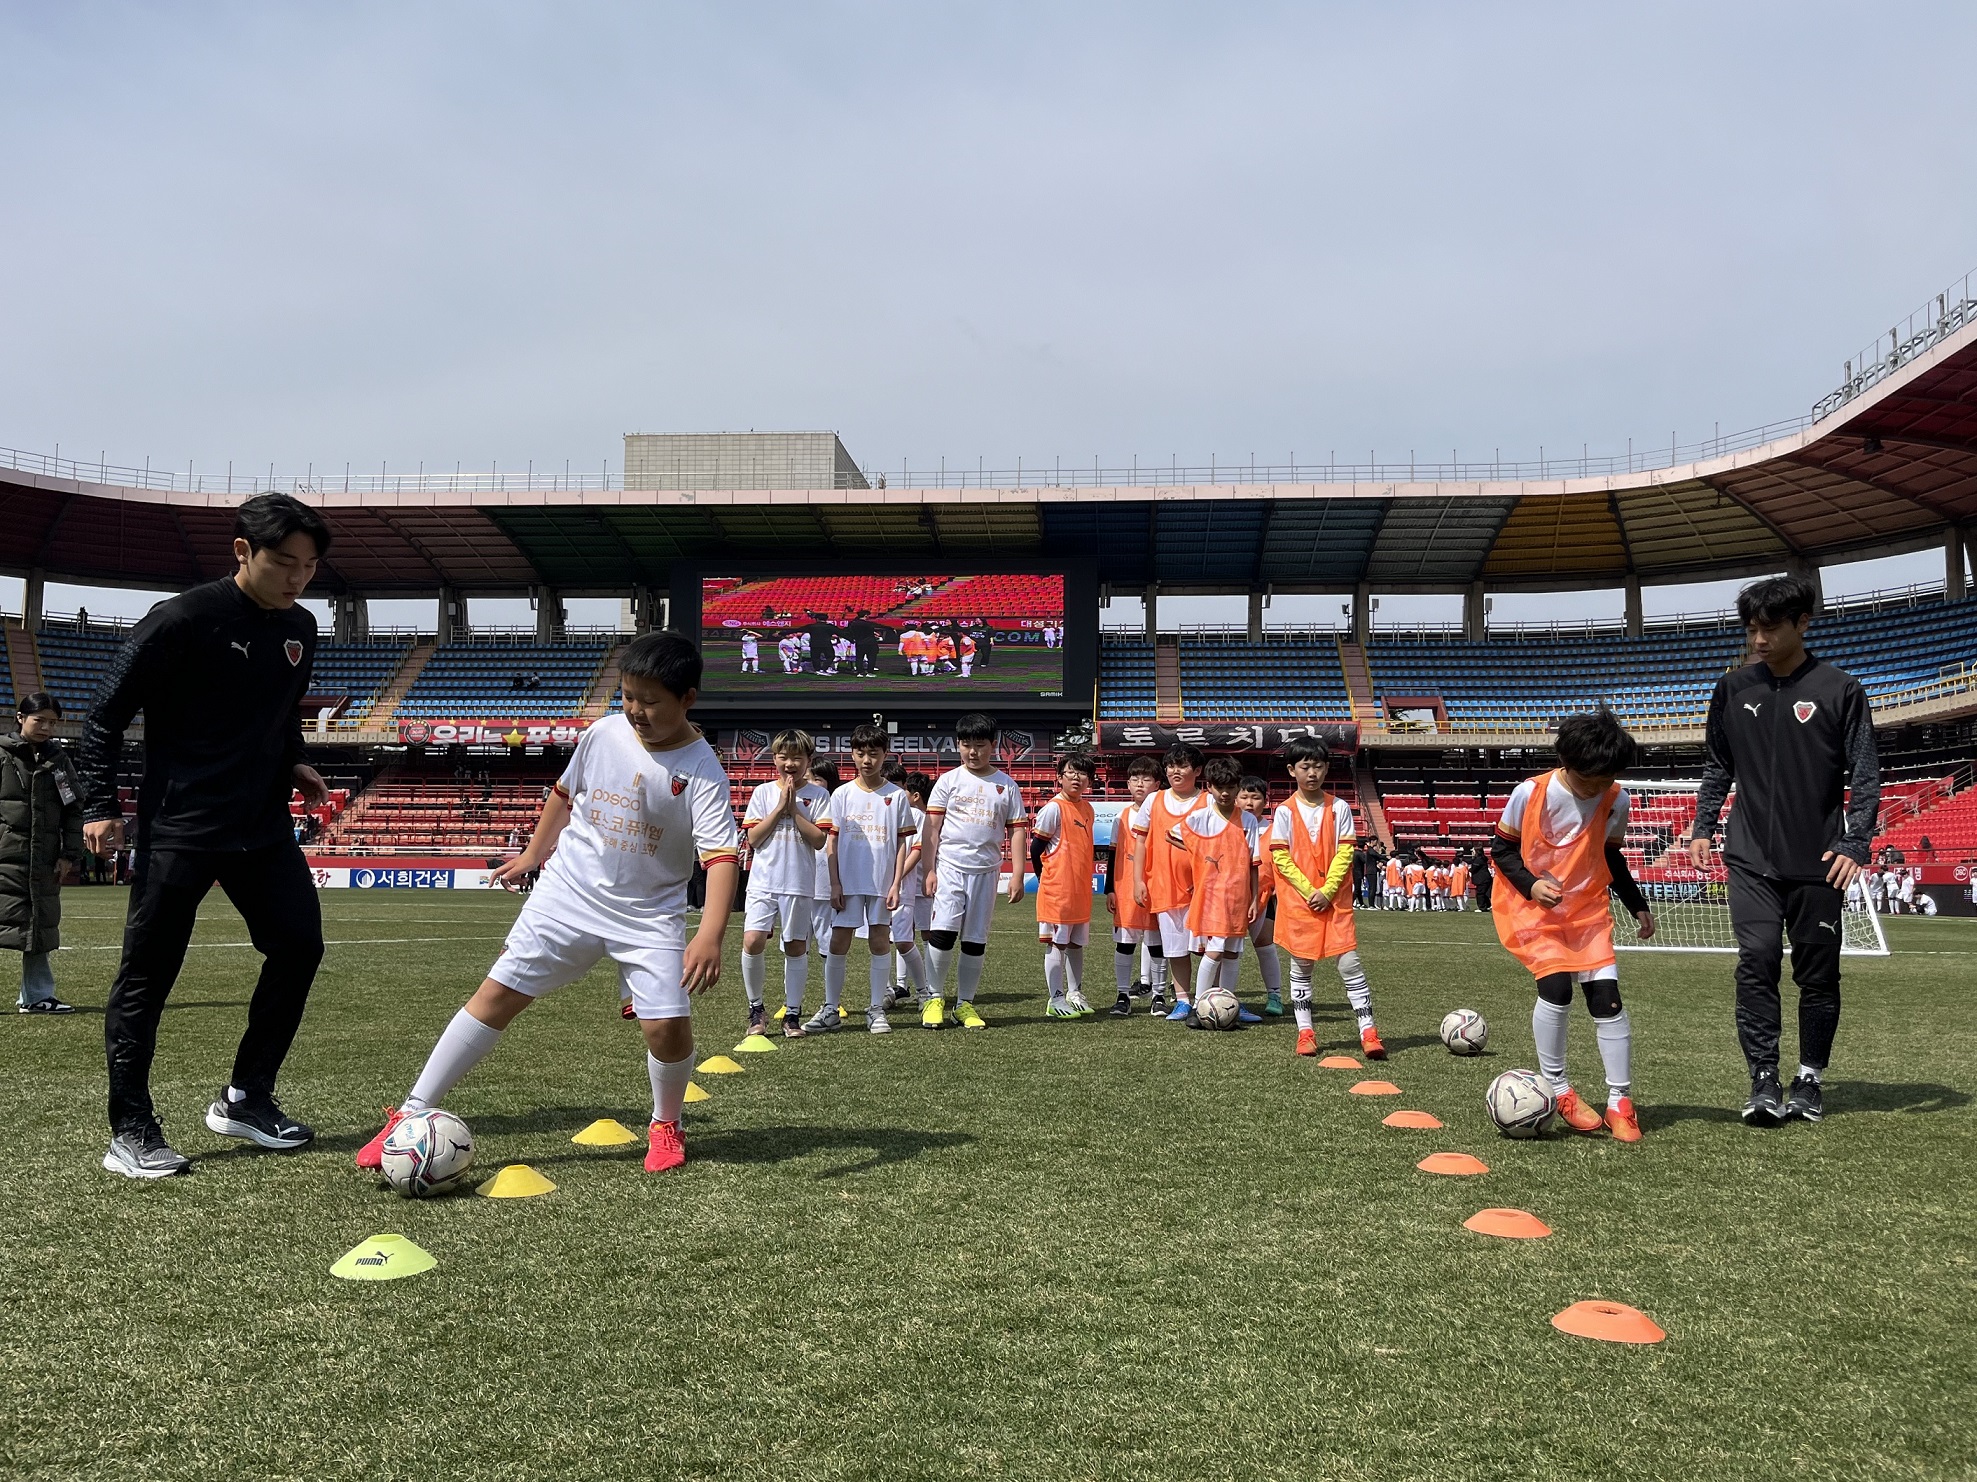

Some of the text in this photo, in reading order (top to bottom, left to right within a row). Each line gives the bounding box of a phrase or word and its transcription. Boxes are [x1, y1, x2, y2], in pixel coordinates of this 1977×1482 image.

[994, 631, 1040, 642] COM
[526, 725, 588, 748] 포항
[888, 736, 960, 753] EELYA
[592, 788, 641, 812] posco
[377, 870, 449, 888] 서희건설
[354, 1257, 385, 1267] PUMA
